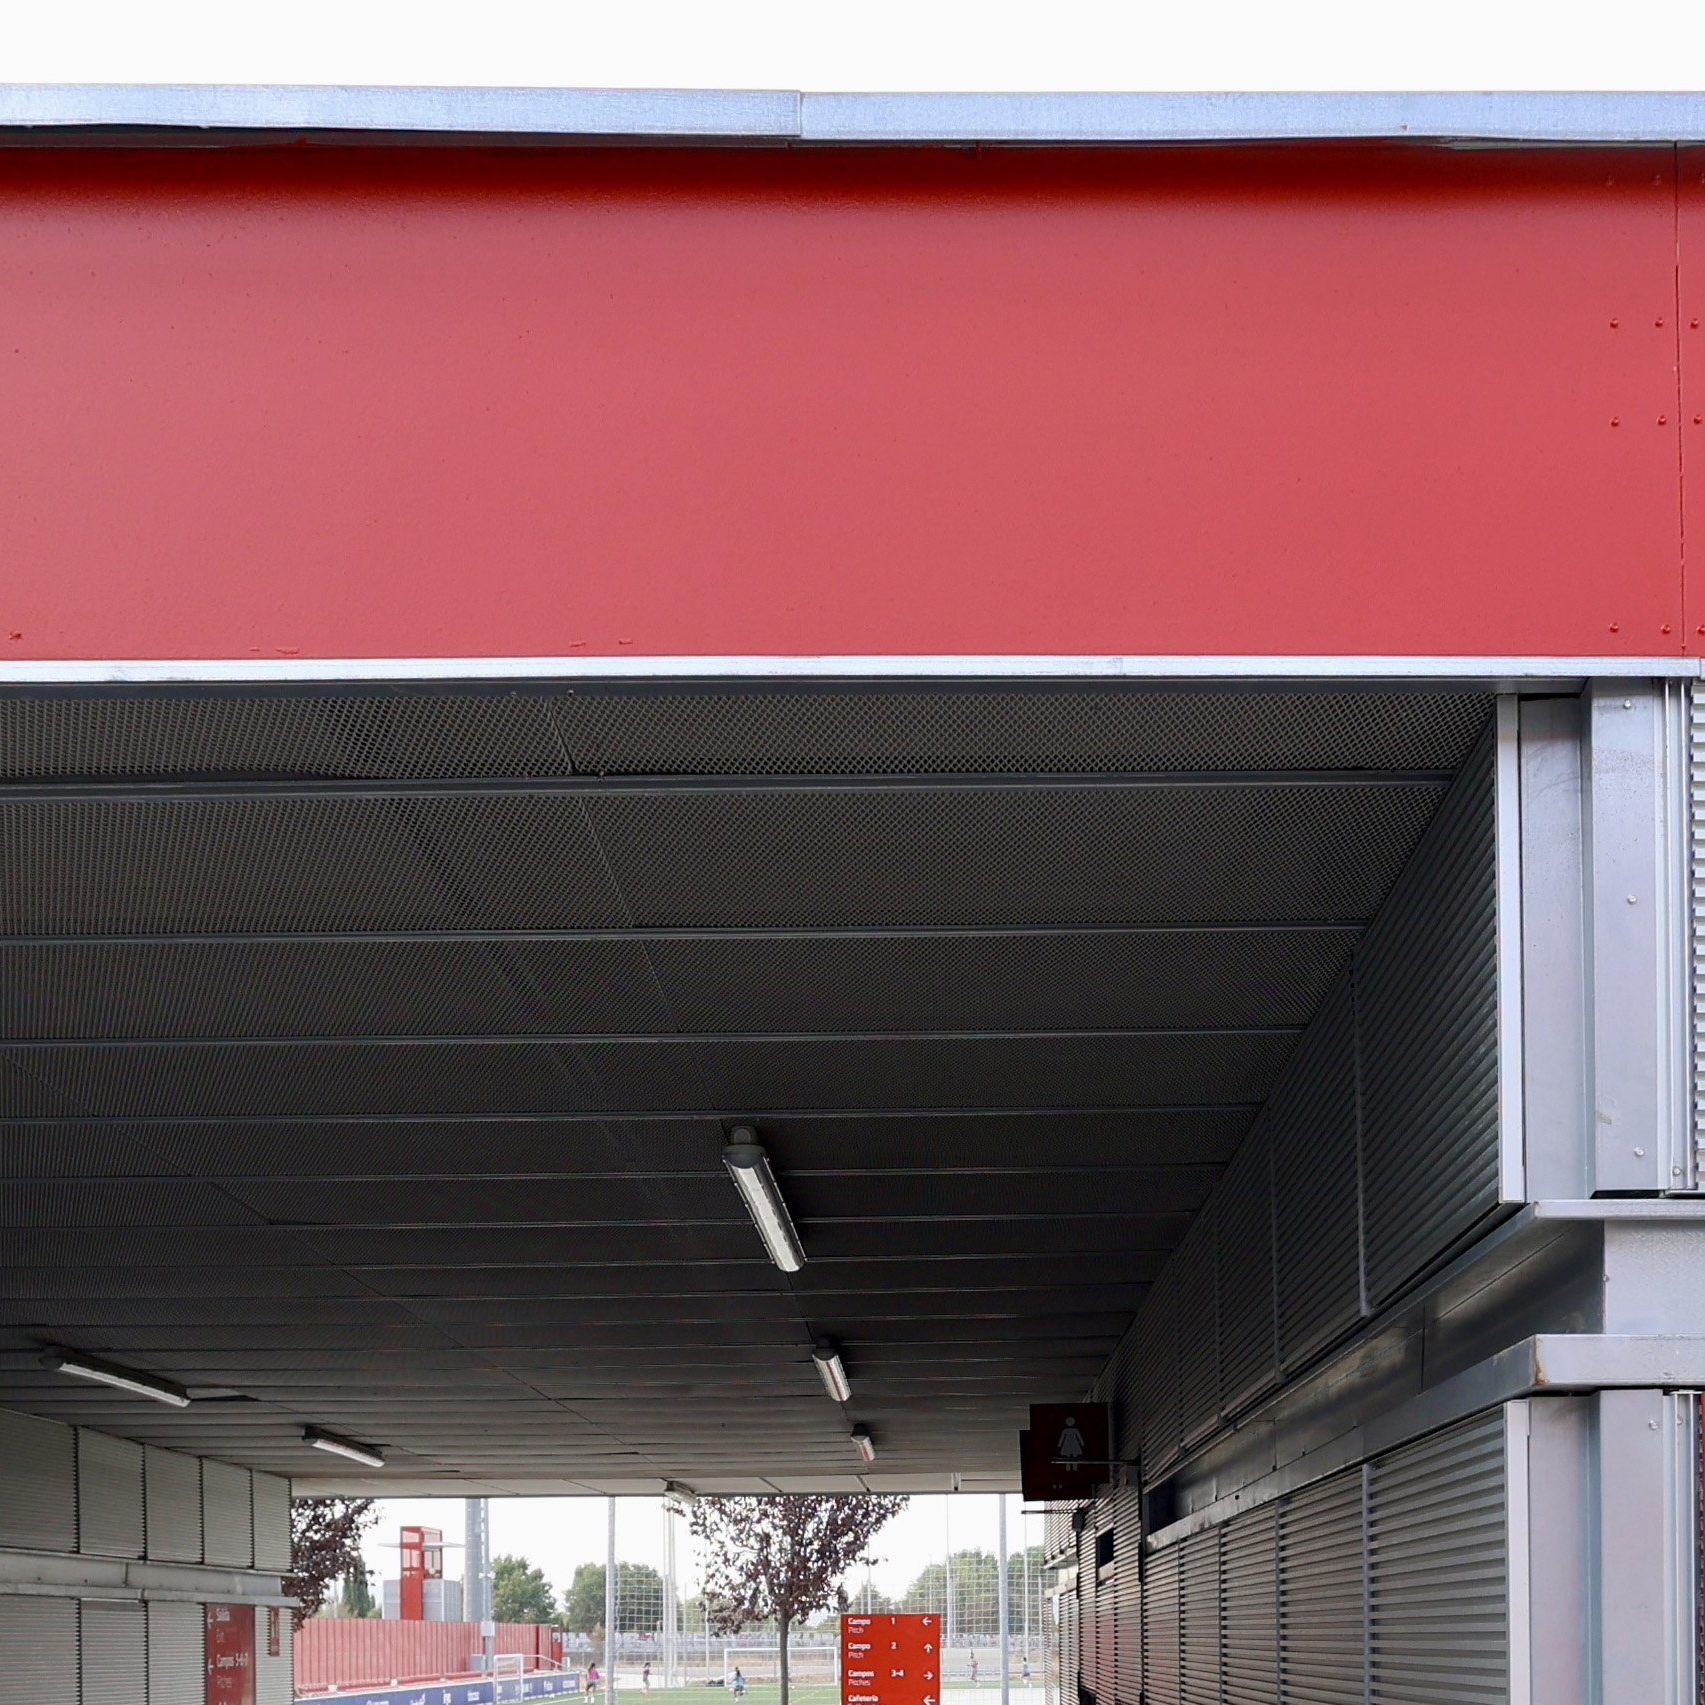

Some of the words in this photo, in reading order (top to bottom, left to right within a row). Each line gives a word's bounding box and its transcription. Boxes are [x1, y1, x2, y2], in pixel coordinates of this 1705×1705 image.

[848, 1617, 871, 1626] Campo
[891, 1617, 896, 1625] 1
[848, 1626, 864, 1634] Pitch
[848, 1642, 871, 1651] Campo
[891, 1641, 897, 1650] 2
[848, 1669, 875, 1678] Campos
[891, 1669, 905, 1677] 3-4
